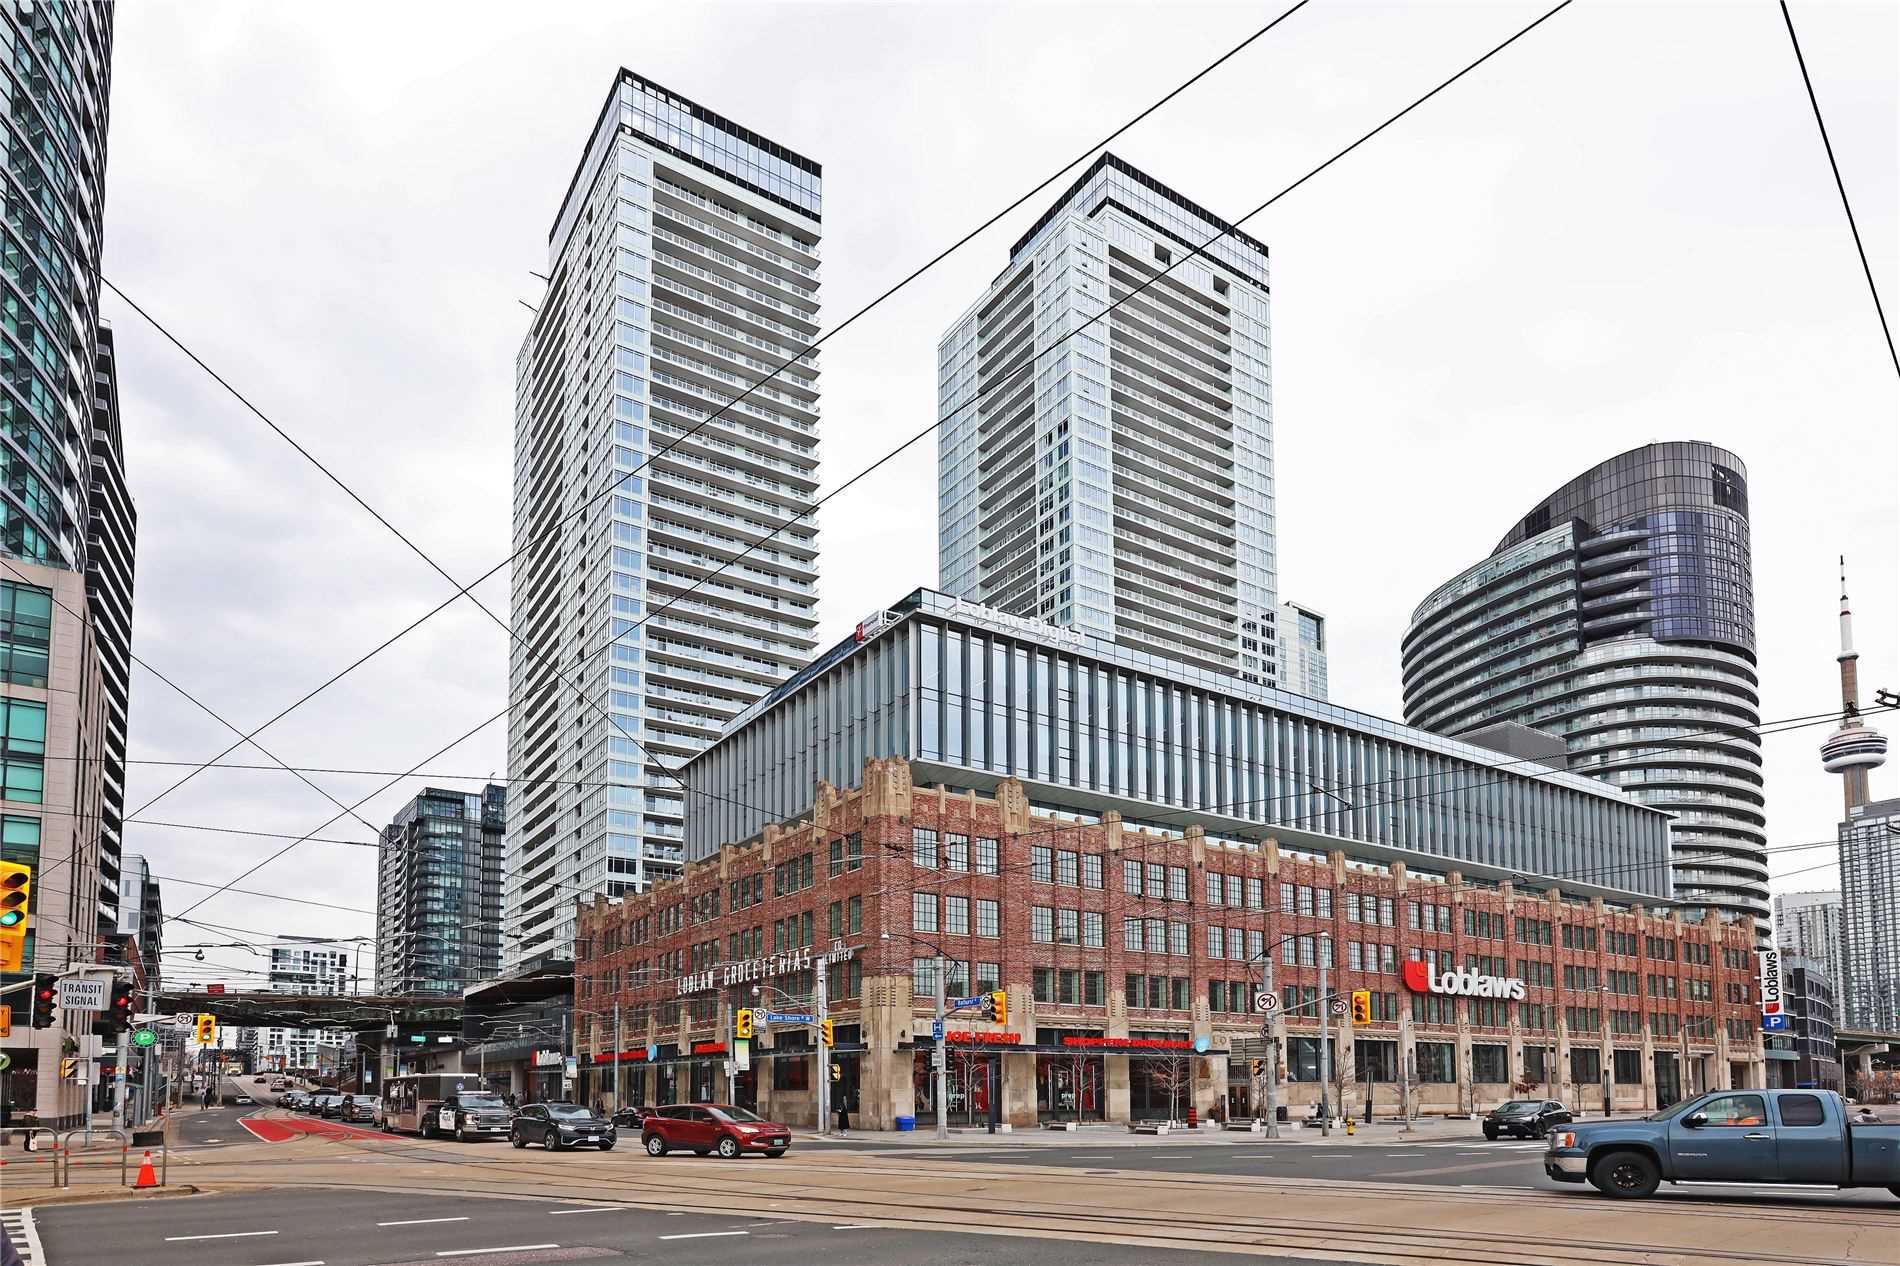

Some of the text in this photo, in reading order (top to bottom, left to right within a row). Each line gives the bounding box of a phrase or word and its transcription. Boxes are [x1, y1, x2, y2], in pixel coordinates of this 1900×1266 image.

[677, 948, 811, 995] LOBLAW GROCETERIAS
[1763, 951, 1780, 1002] Loblaws
[63, 983, 103, 994] TRANSIT
[1427, 962, 1526, 1000] Loblaws
[65, 995, 98, 1006] SIGNAL
[1770, 1017, 1781, 1028] P
[945, 1030, 1021, 1045] JOE FRESH
